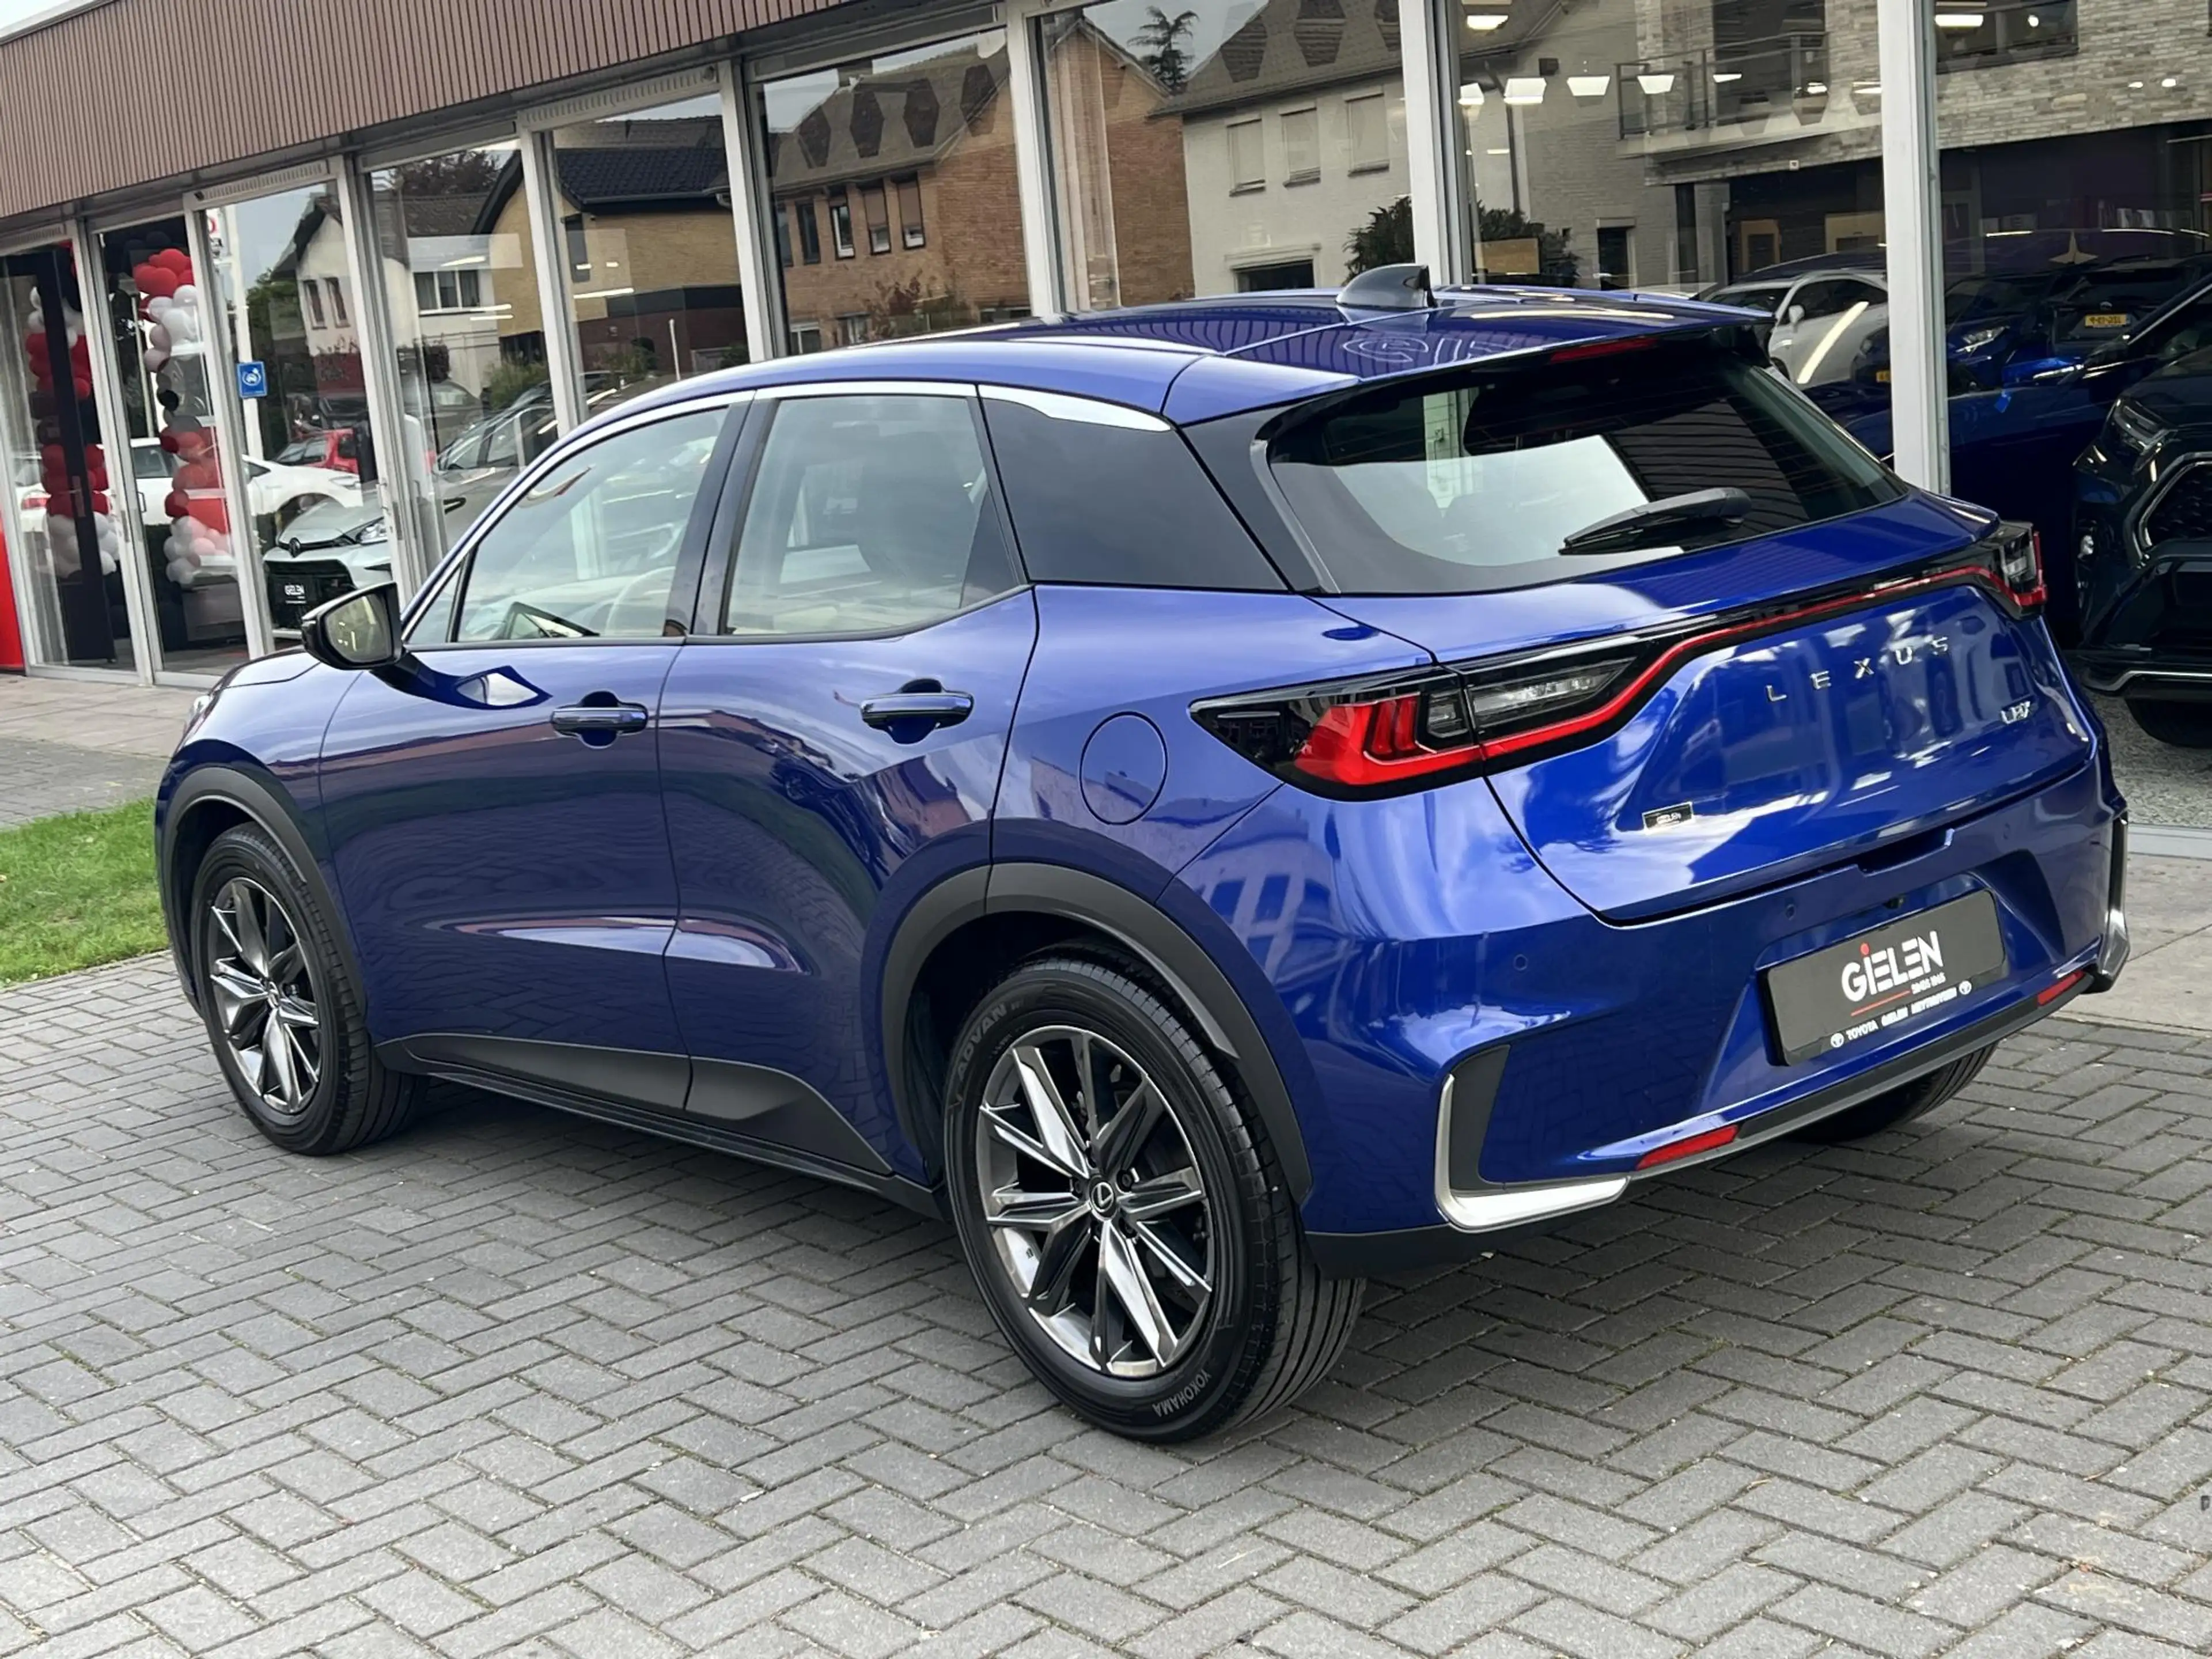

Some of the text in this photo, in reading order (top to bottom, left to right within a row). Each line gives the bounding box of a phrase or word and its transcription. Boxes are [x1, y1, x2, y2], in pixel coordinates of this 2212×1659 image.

[1765, 637, 1948, 702] LEXUS
[957, 1003, 1007, 1081] ADVAN
[1846, 1020, 1879, 1040] TOYOTA
[1152, 1369, 1212, 1417] YOKOHAMA
